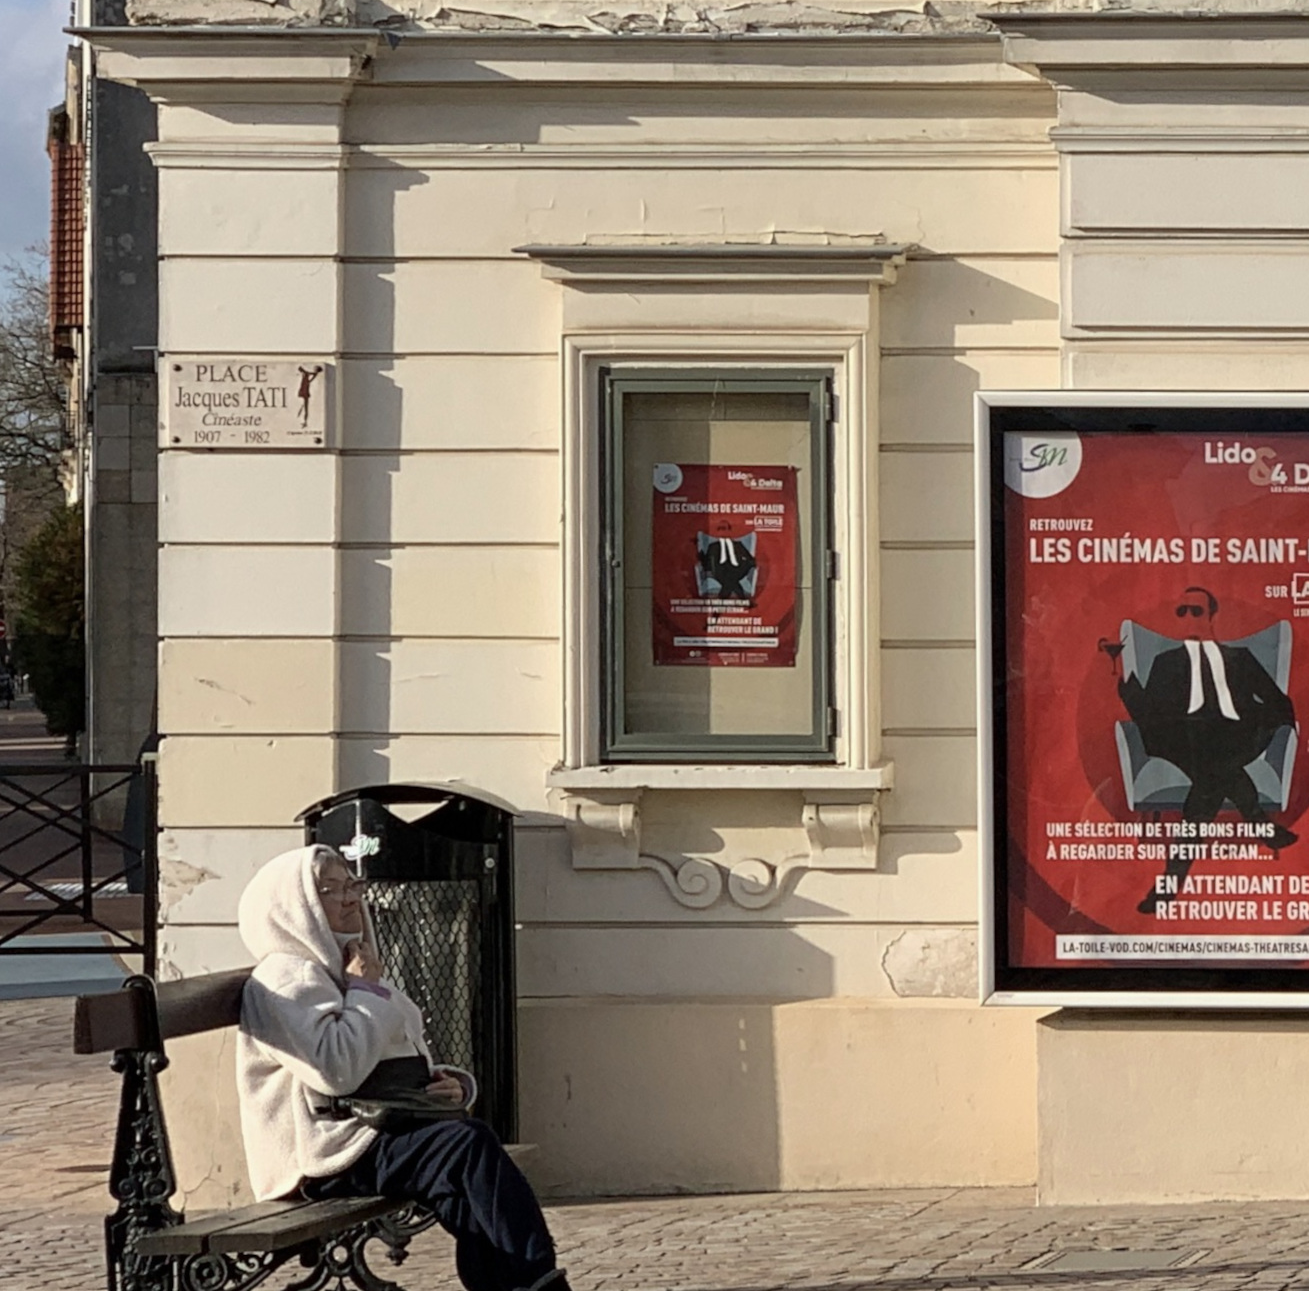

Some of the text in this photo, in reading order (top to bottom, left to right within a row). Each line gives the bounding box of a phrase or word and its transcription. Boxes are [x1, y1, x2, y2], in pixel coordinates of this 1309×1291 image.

[196, 365, 268, 383] PLACE
[175, 386, 288, 412] Jacques TATI
[202, 412, 263, 427] Cinéaste
[194, 430, 221, 444] 1907
[245, 430, 270, 444] 1982
[1204, 441, 1257, 464] Lido
[1270, 463, 1288, 485] 4
[665, 501, 784, 514] LES CINÉMAS DE SAINT-MAUR
[1030, 519, 1093, 532] RETROUVEZ
[1030, 538, 1071, 563] LES
[1078, 533, 1184, 564] CINÉMAS
[1192, 538, 1220, 563] DE
[1265, 585, 1288, 598] SUR
[1046, 820, 1275, 837] UNE SÉLECTION DE TRÈS BONS FILMS
[1046, 841, 1273, 860] À REGARDER SUR PETIT ÉCRAN...
[1155, 876, 1177, 894] EN
[1183, 876, 1284, 894] ATTENDANT
[1155, 901, 1257, 919] RETROUVER
[1263, 901, 1282, 919] LE
